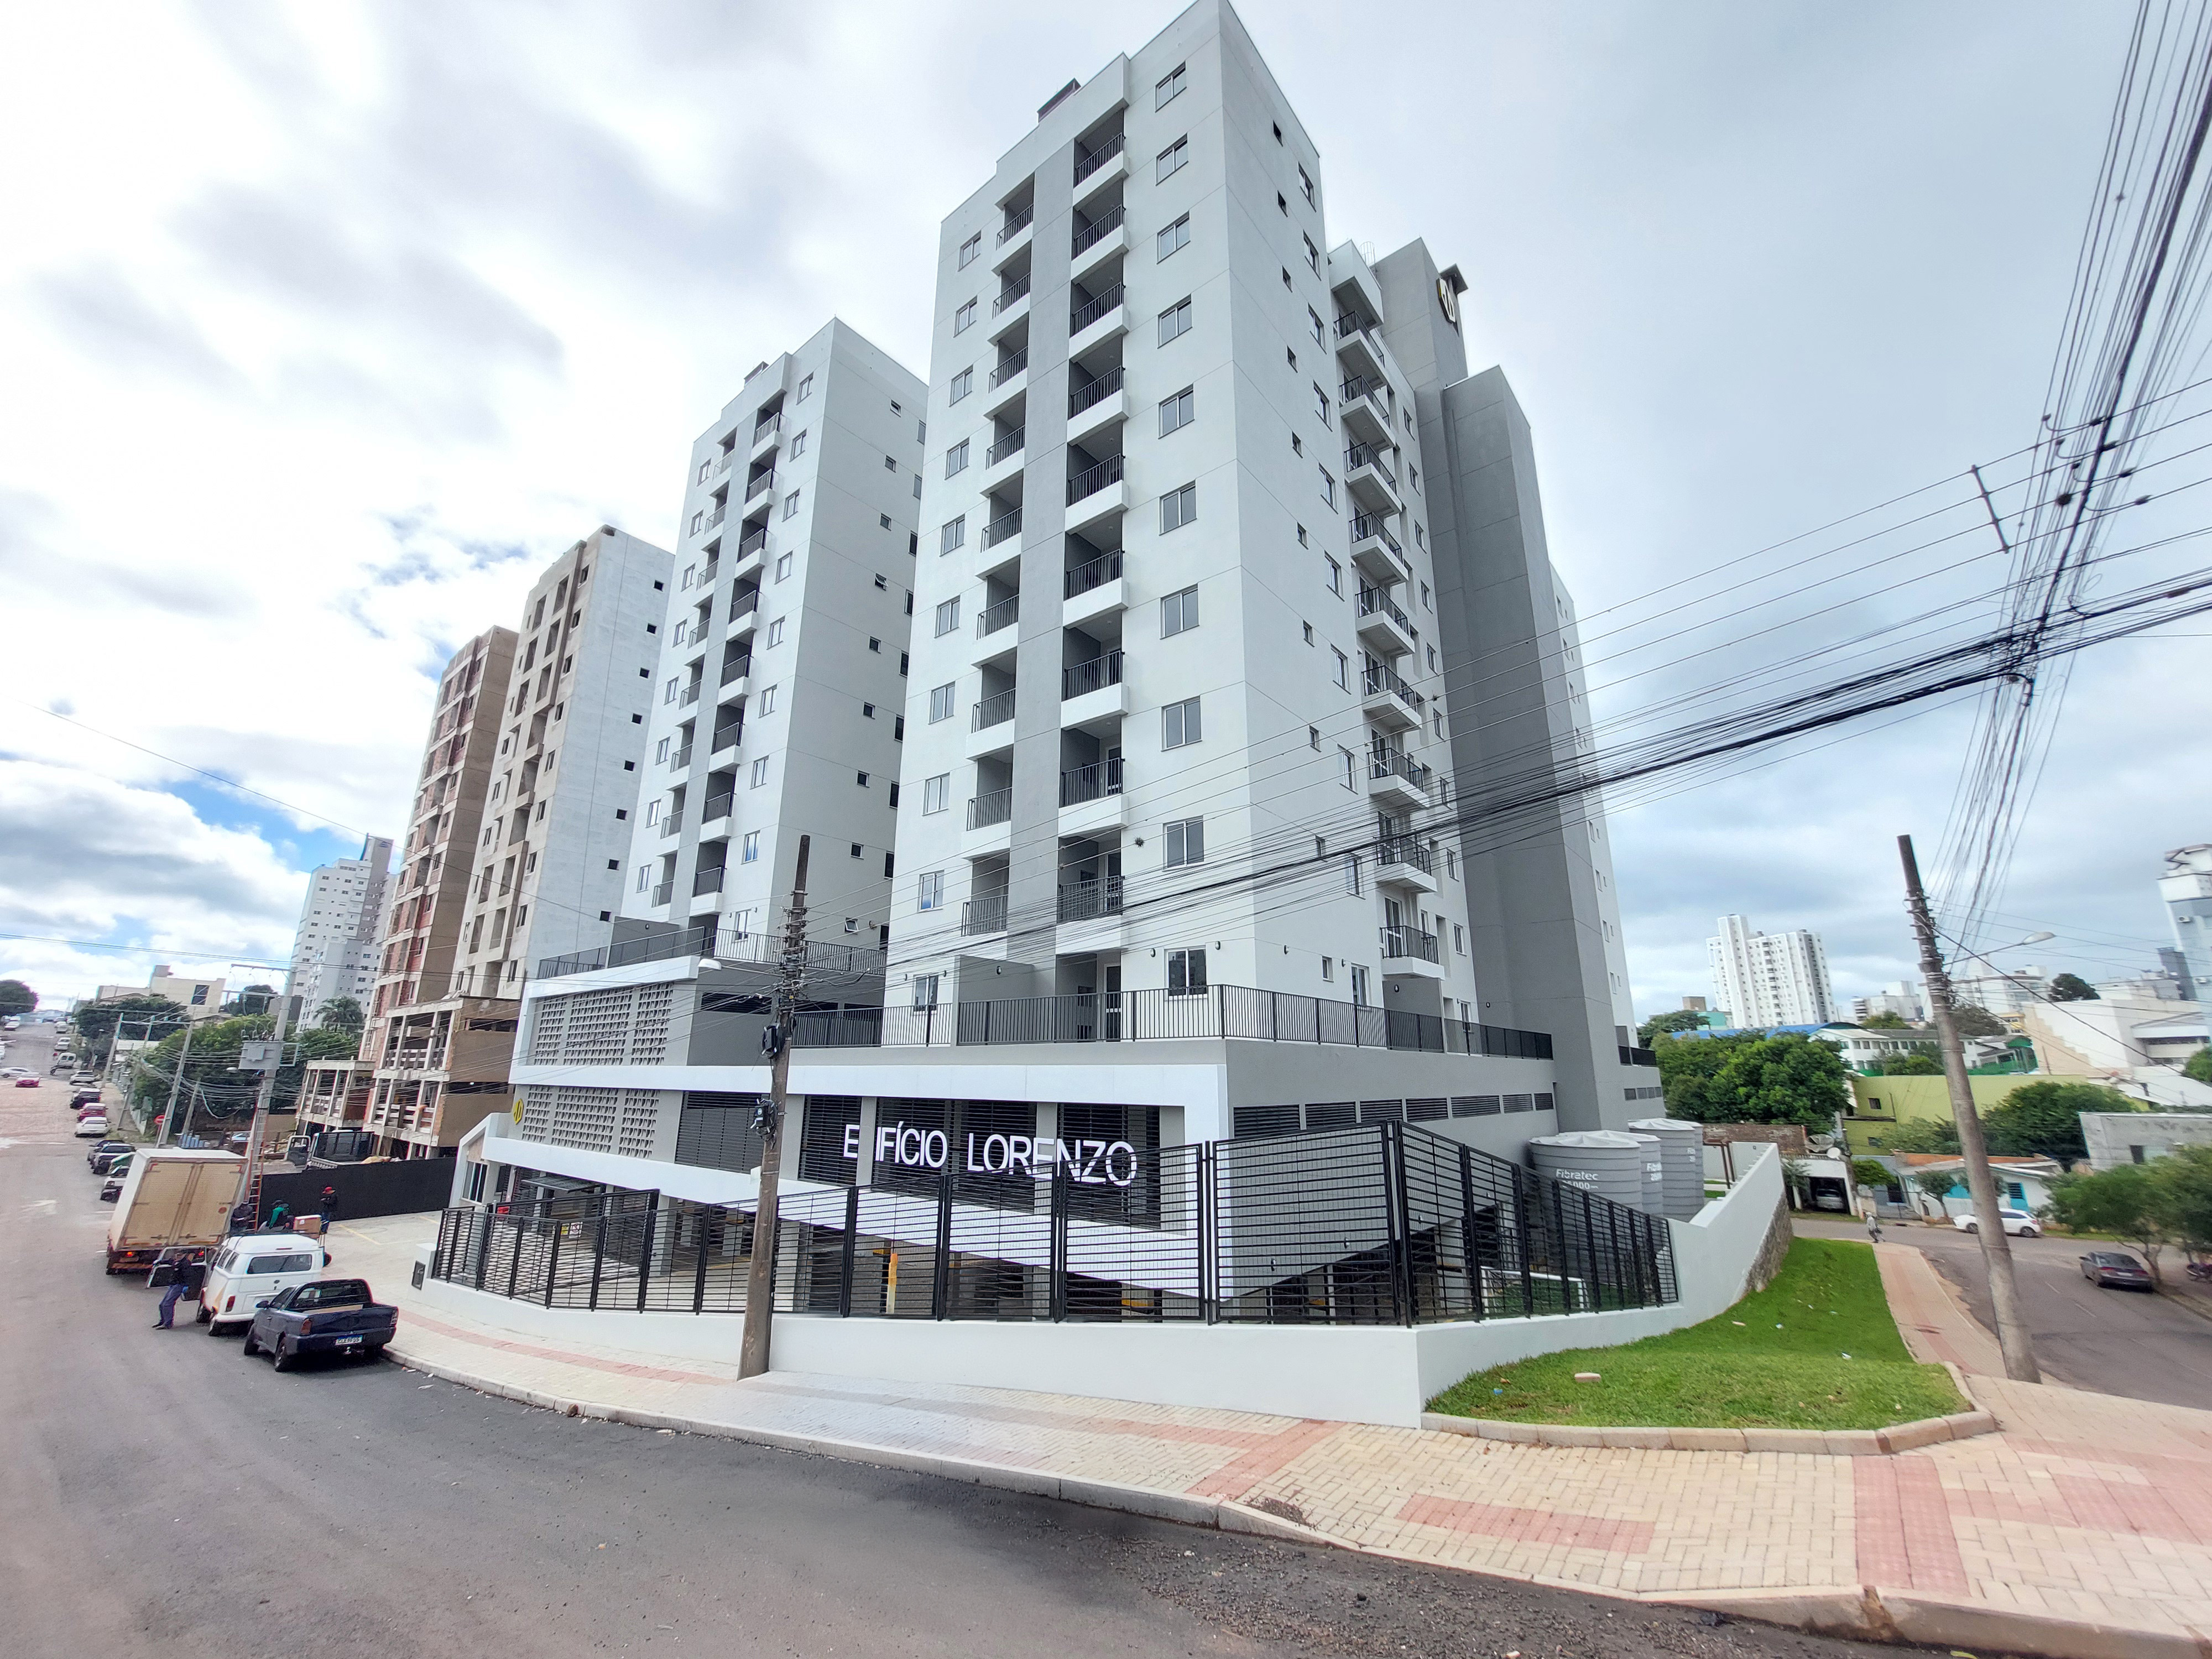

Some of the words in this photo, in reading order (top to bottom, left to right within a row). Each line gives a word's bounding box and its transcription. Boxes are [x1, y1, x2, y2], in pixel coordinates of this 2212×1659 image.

[843, 1121, 948, 1168] EIFÍCIO
[968, 1133, 1137, 1186] LORENZO
[1556, 1168, 1599, 1181] Fibratec
